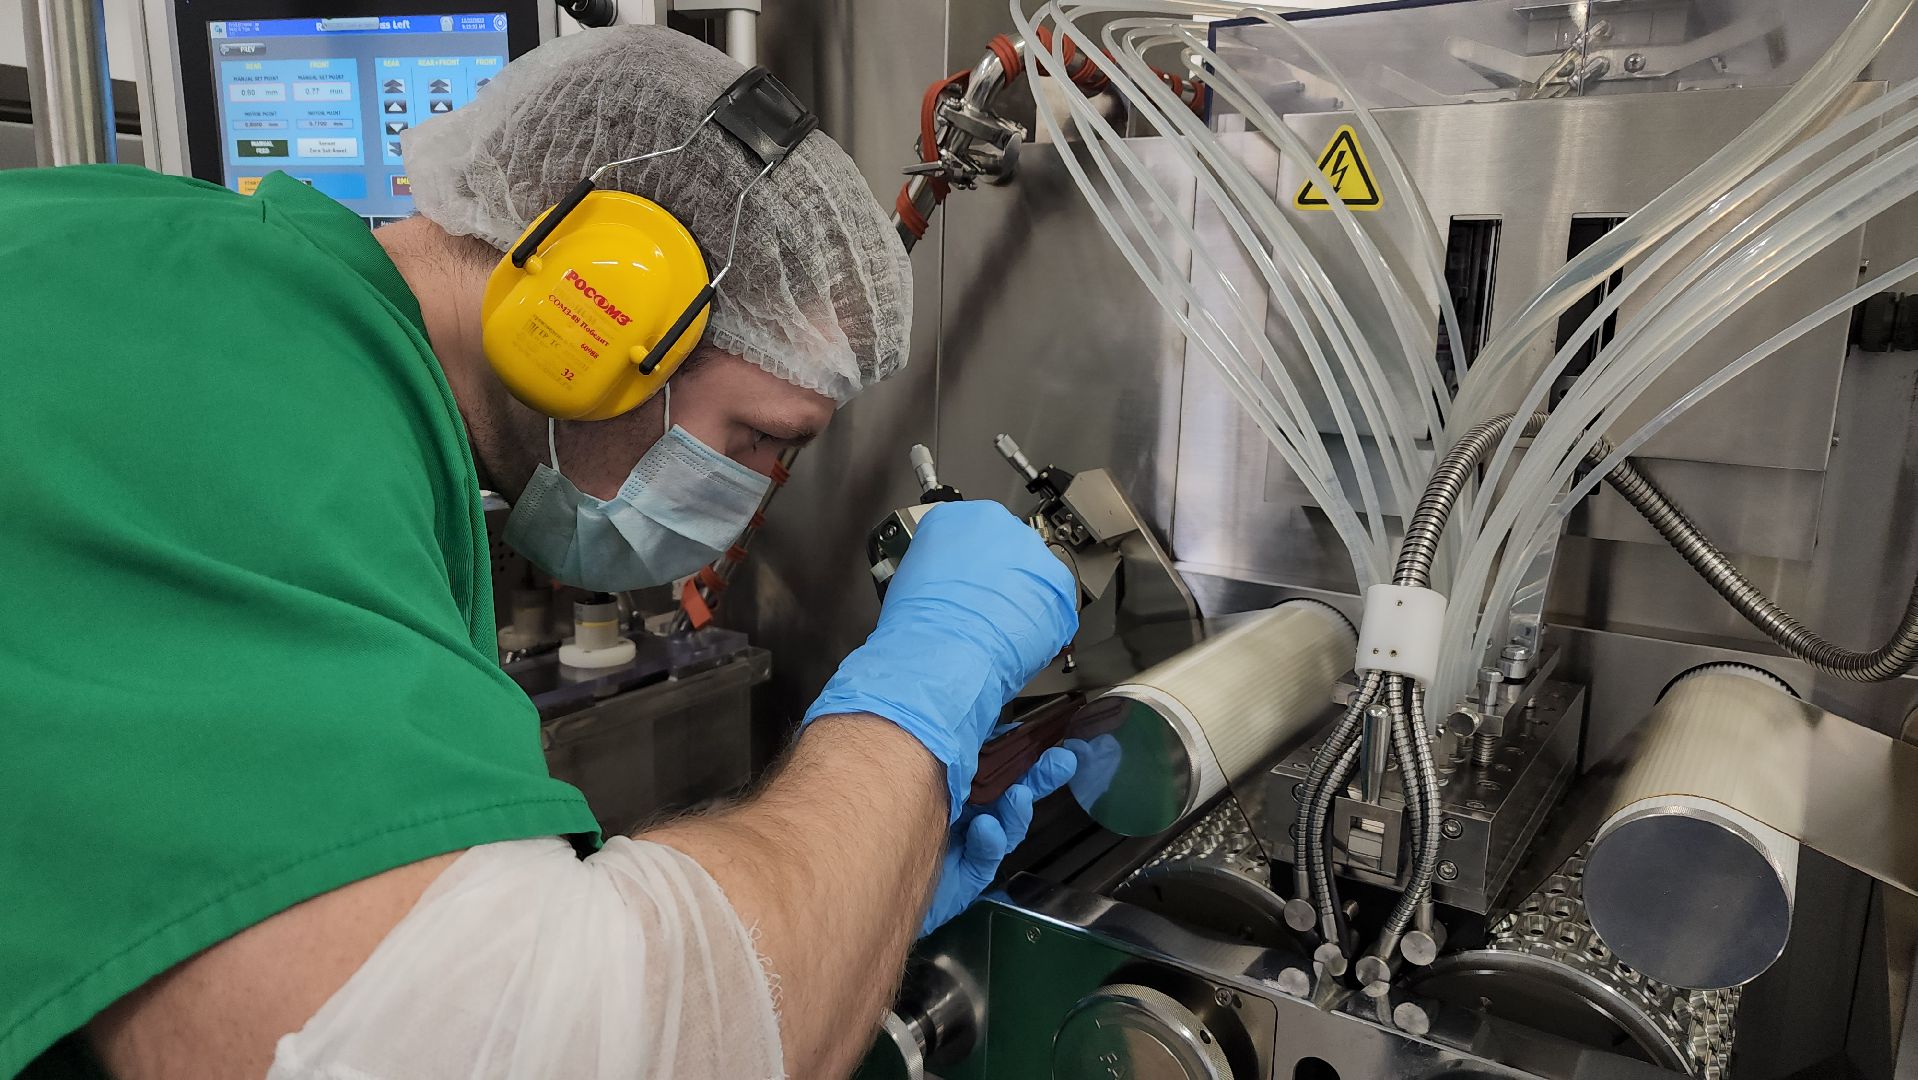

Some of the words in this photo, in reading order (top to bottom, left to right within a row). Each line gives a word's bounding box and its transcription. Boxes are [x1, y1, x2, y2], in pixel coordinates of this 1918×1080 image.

[392, 19, 410, 29] Left
[565, 269, 632, 325] РОСОМЗ
[560, 368, 575, 381] 32
